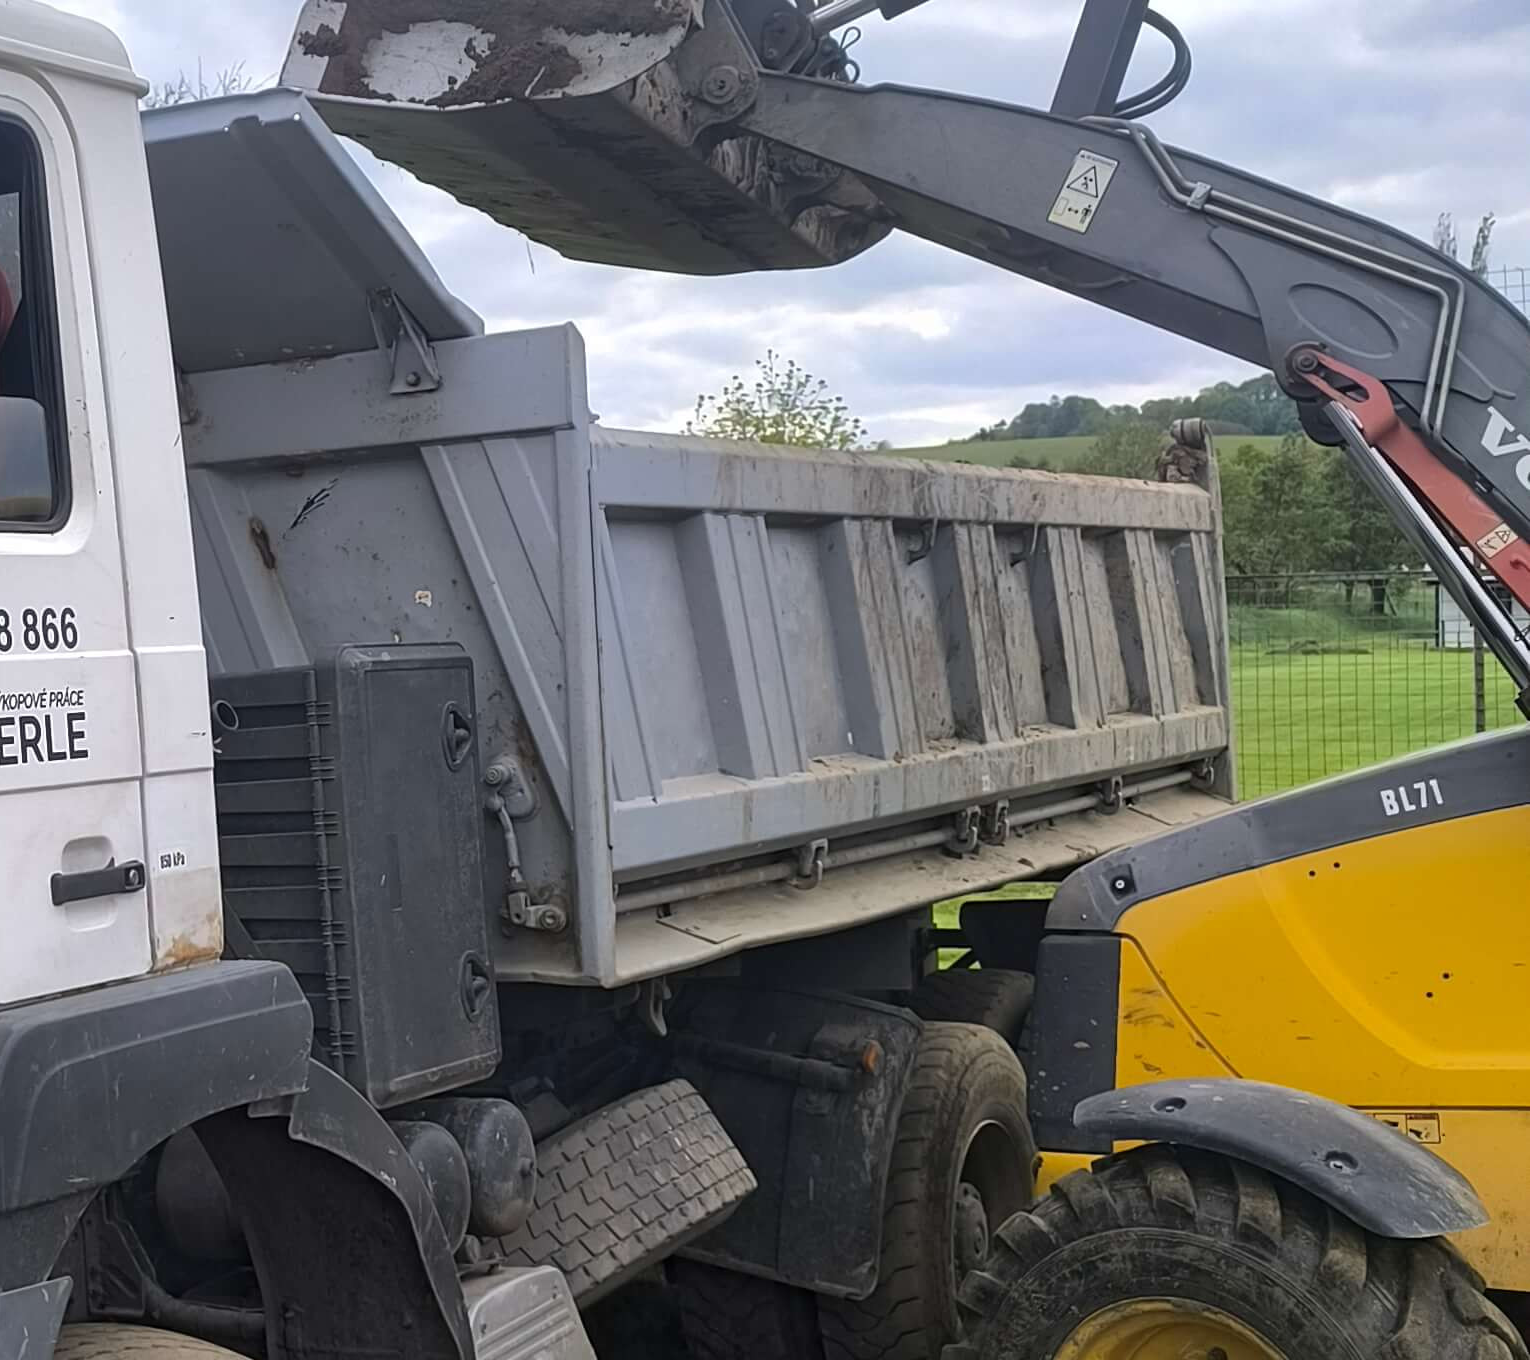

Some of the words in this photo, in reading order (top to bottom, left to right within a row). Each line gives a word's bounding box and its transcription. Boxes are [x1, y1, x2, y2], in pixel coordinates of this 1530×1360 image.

[22, 607, 78, 651] 866
[49, 687, 85, 707] PRÁCE
[1380, 779, 1444, 816] BL71
